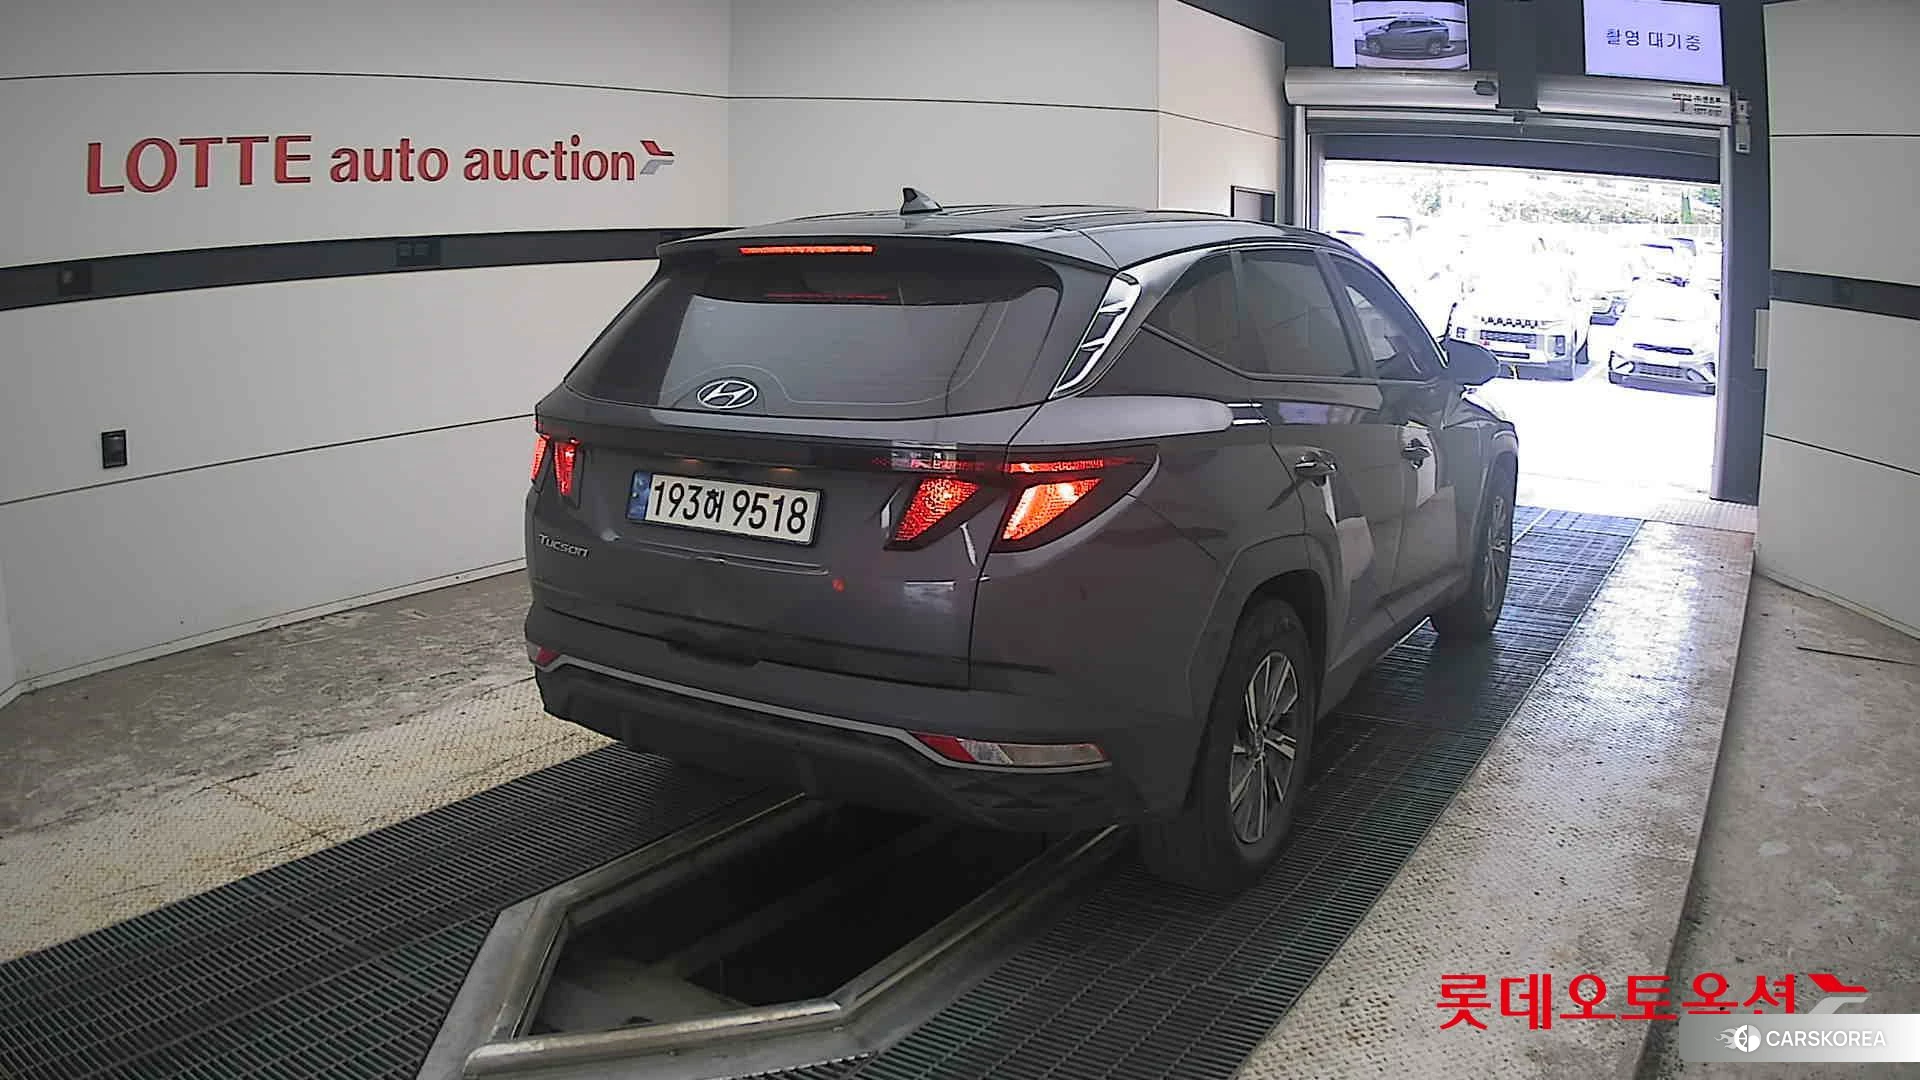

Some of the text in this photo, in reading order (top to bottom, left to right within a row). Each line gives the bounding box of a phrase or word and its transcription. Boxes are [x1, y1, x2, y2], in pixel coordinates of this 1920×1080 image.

[1607, 28, 1701, 51] 촬영 대기중
[87, 134, 636, 194] LOTTE auto auction
[732, 489, 808, 534] 9518
